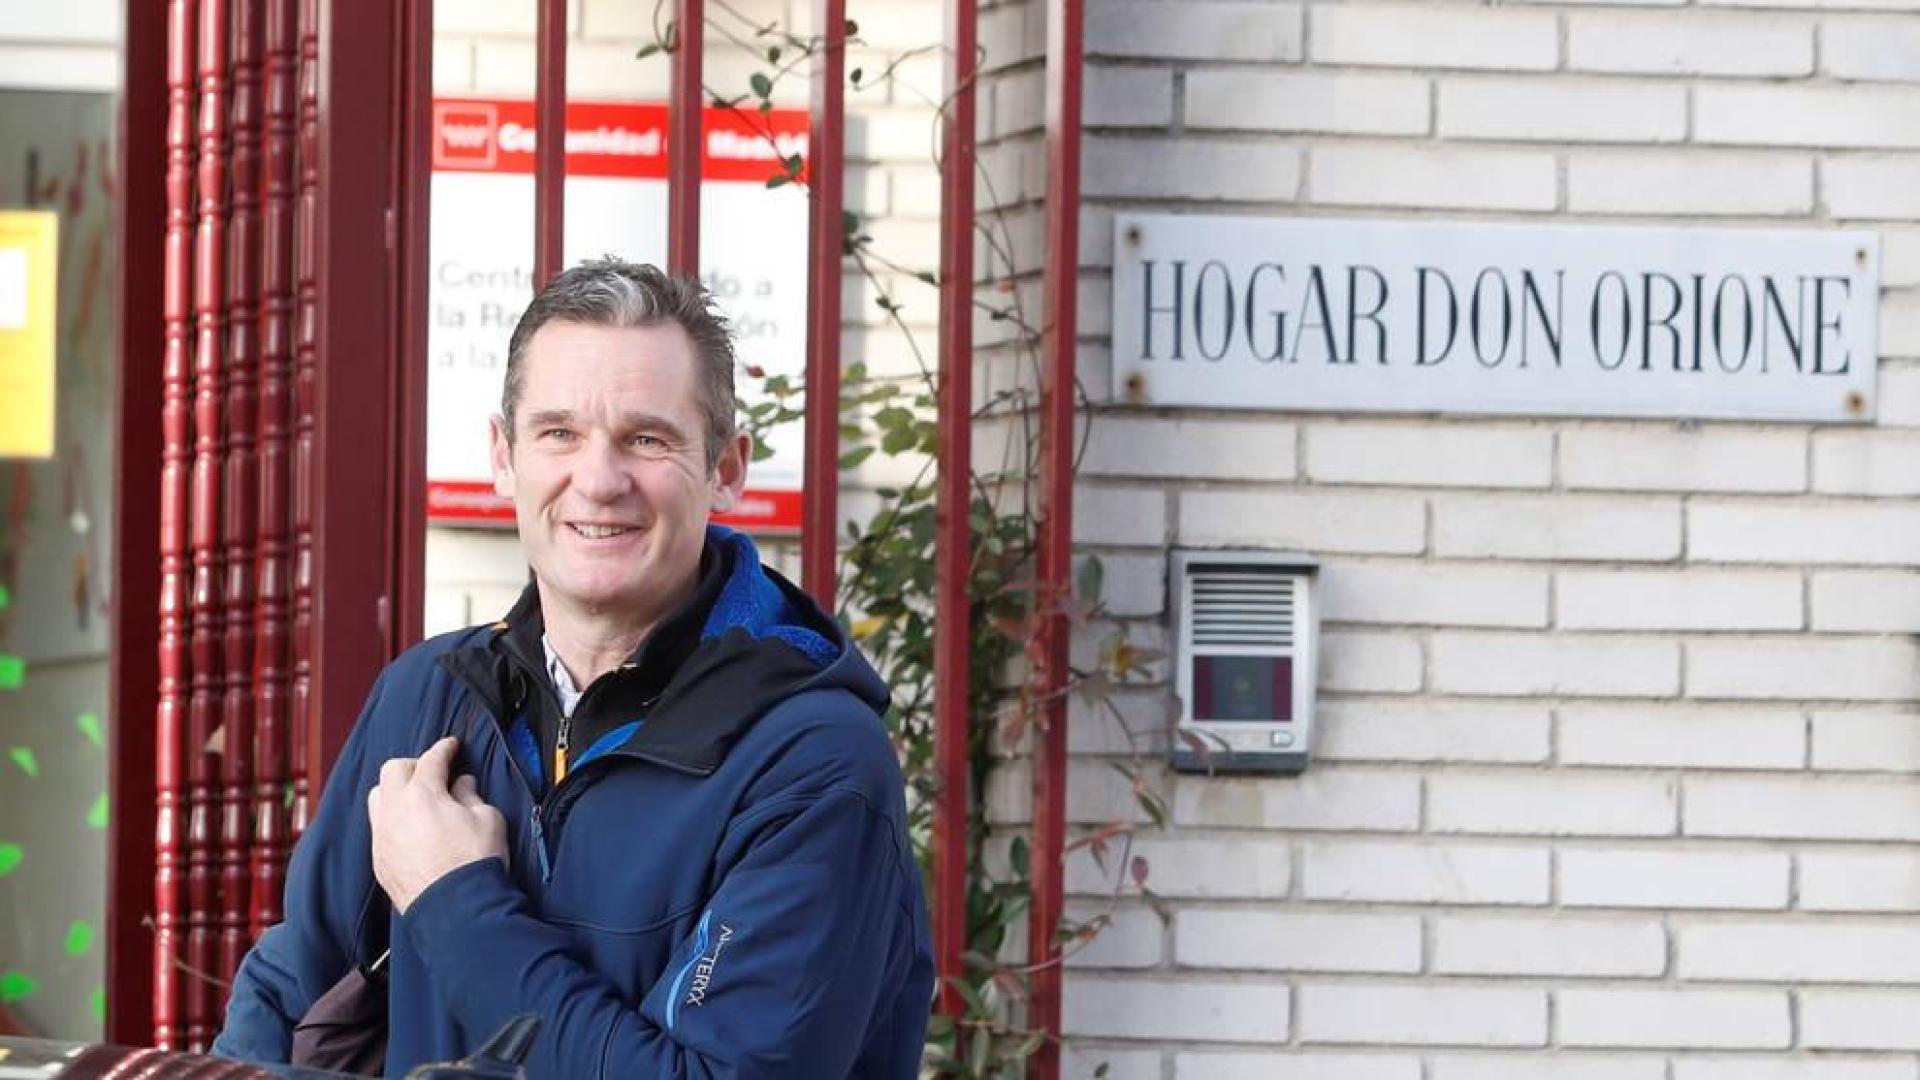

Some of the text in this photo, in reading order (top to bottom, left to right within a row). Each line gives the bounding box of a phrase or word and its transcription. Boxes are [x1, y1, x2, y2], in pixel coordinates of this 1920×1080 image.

[498, 122, 661, 155] Counidad
[436, 301, 466, 327] la
[1139, 259, 1850, 377] HOGAR DON ORIONE
